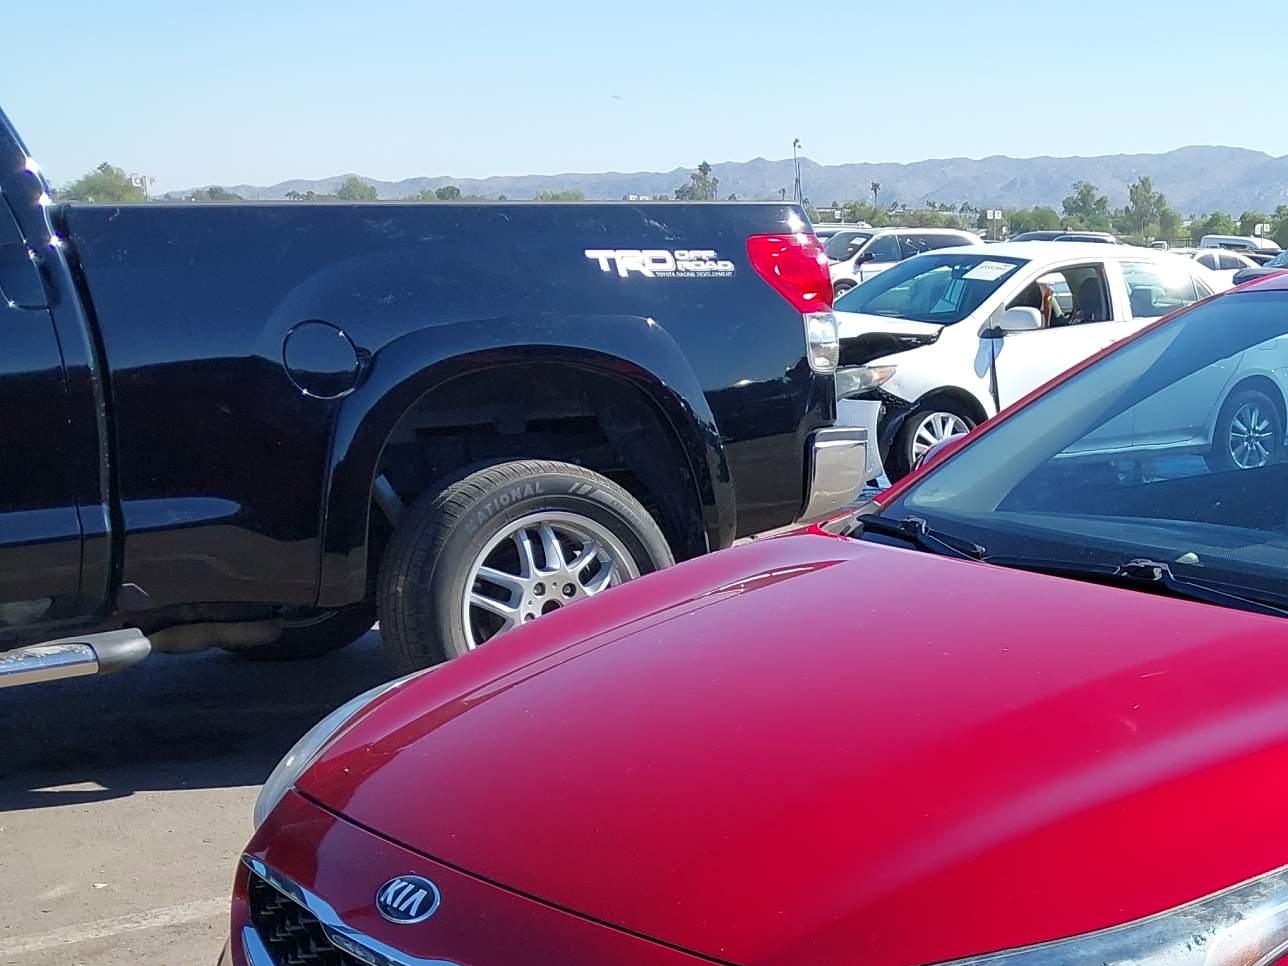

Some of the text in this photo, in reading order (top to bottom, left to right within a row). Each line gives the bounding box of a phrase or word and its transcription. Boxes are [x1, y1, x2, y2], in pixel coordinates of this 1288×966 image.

[584, 249, 675, 277] TRD
[674, 249, 717, 260] OFF
[676, 260, 735, 271] ROAD
[380, 880, 427, 917] KIA
